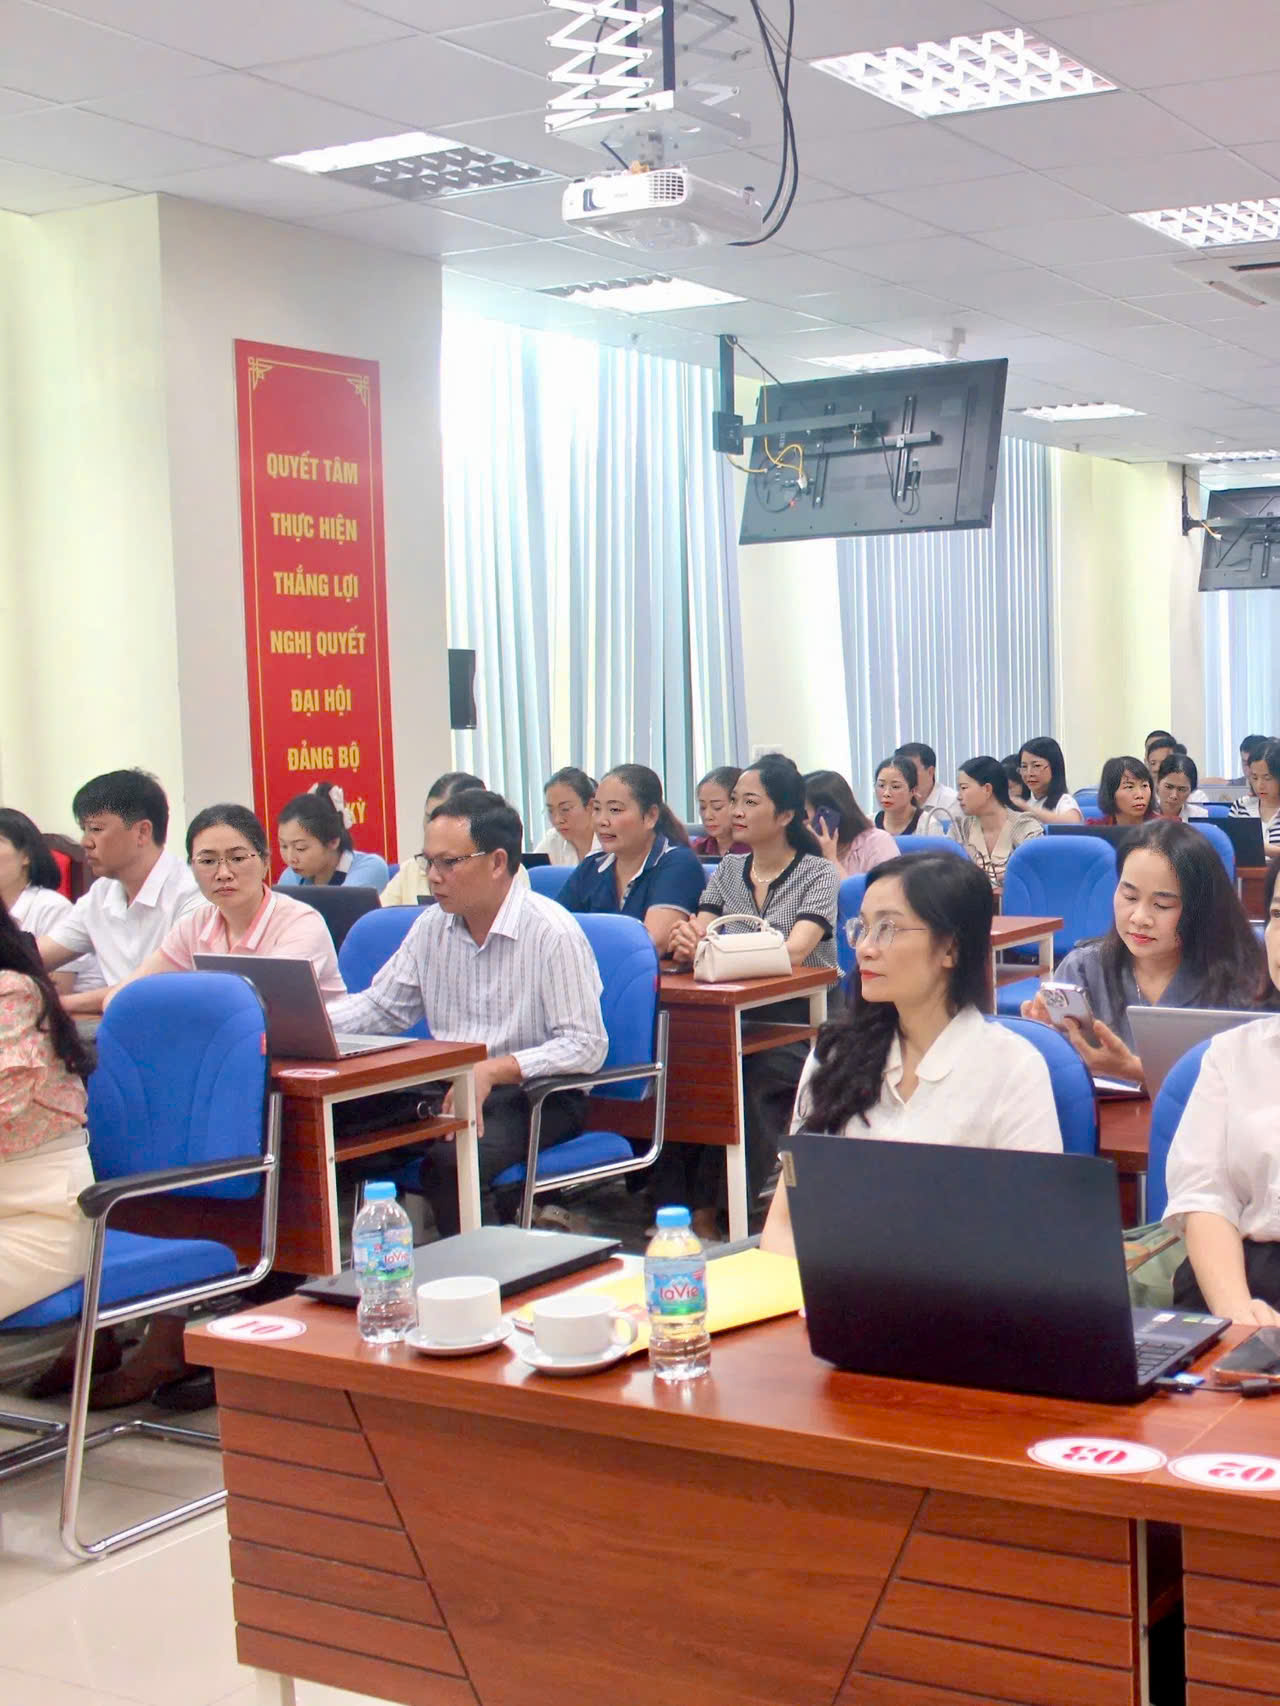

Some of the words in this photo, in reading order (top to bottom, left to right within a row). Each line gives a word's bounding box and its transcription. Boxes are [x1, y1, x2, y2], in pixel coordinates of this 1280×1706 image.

[266, 450, 319, 480] QUYẾT
[323, 456, 359, 485] TÂM
[270, 512, 315, 542] THỰC
[319, 513, 358, 545] HIỆN
[273, 564, 329, 597] THẮNG
[333, 574, 359, 602] LỢI
[270, 631, 312, 659] NGHỊ
[317, 625, 366, 656] QUYẾT
[291, 689, 320, 717] ĐẠI
[324, 684, 352, 717] HỘI
[288, 740, 334, 771] ĐẢNG
[338, 741, 360, 773] BỘ
[1061, 1445, 1128, 1465] 03
[1207, 1462, 1276, 1482] 02
